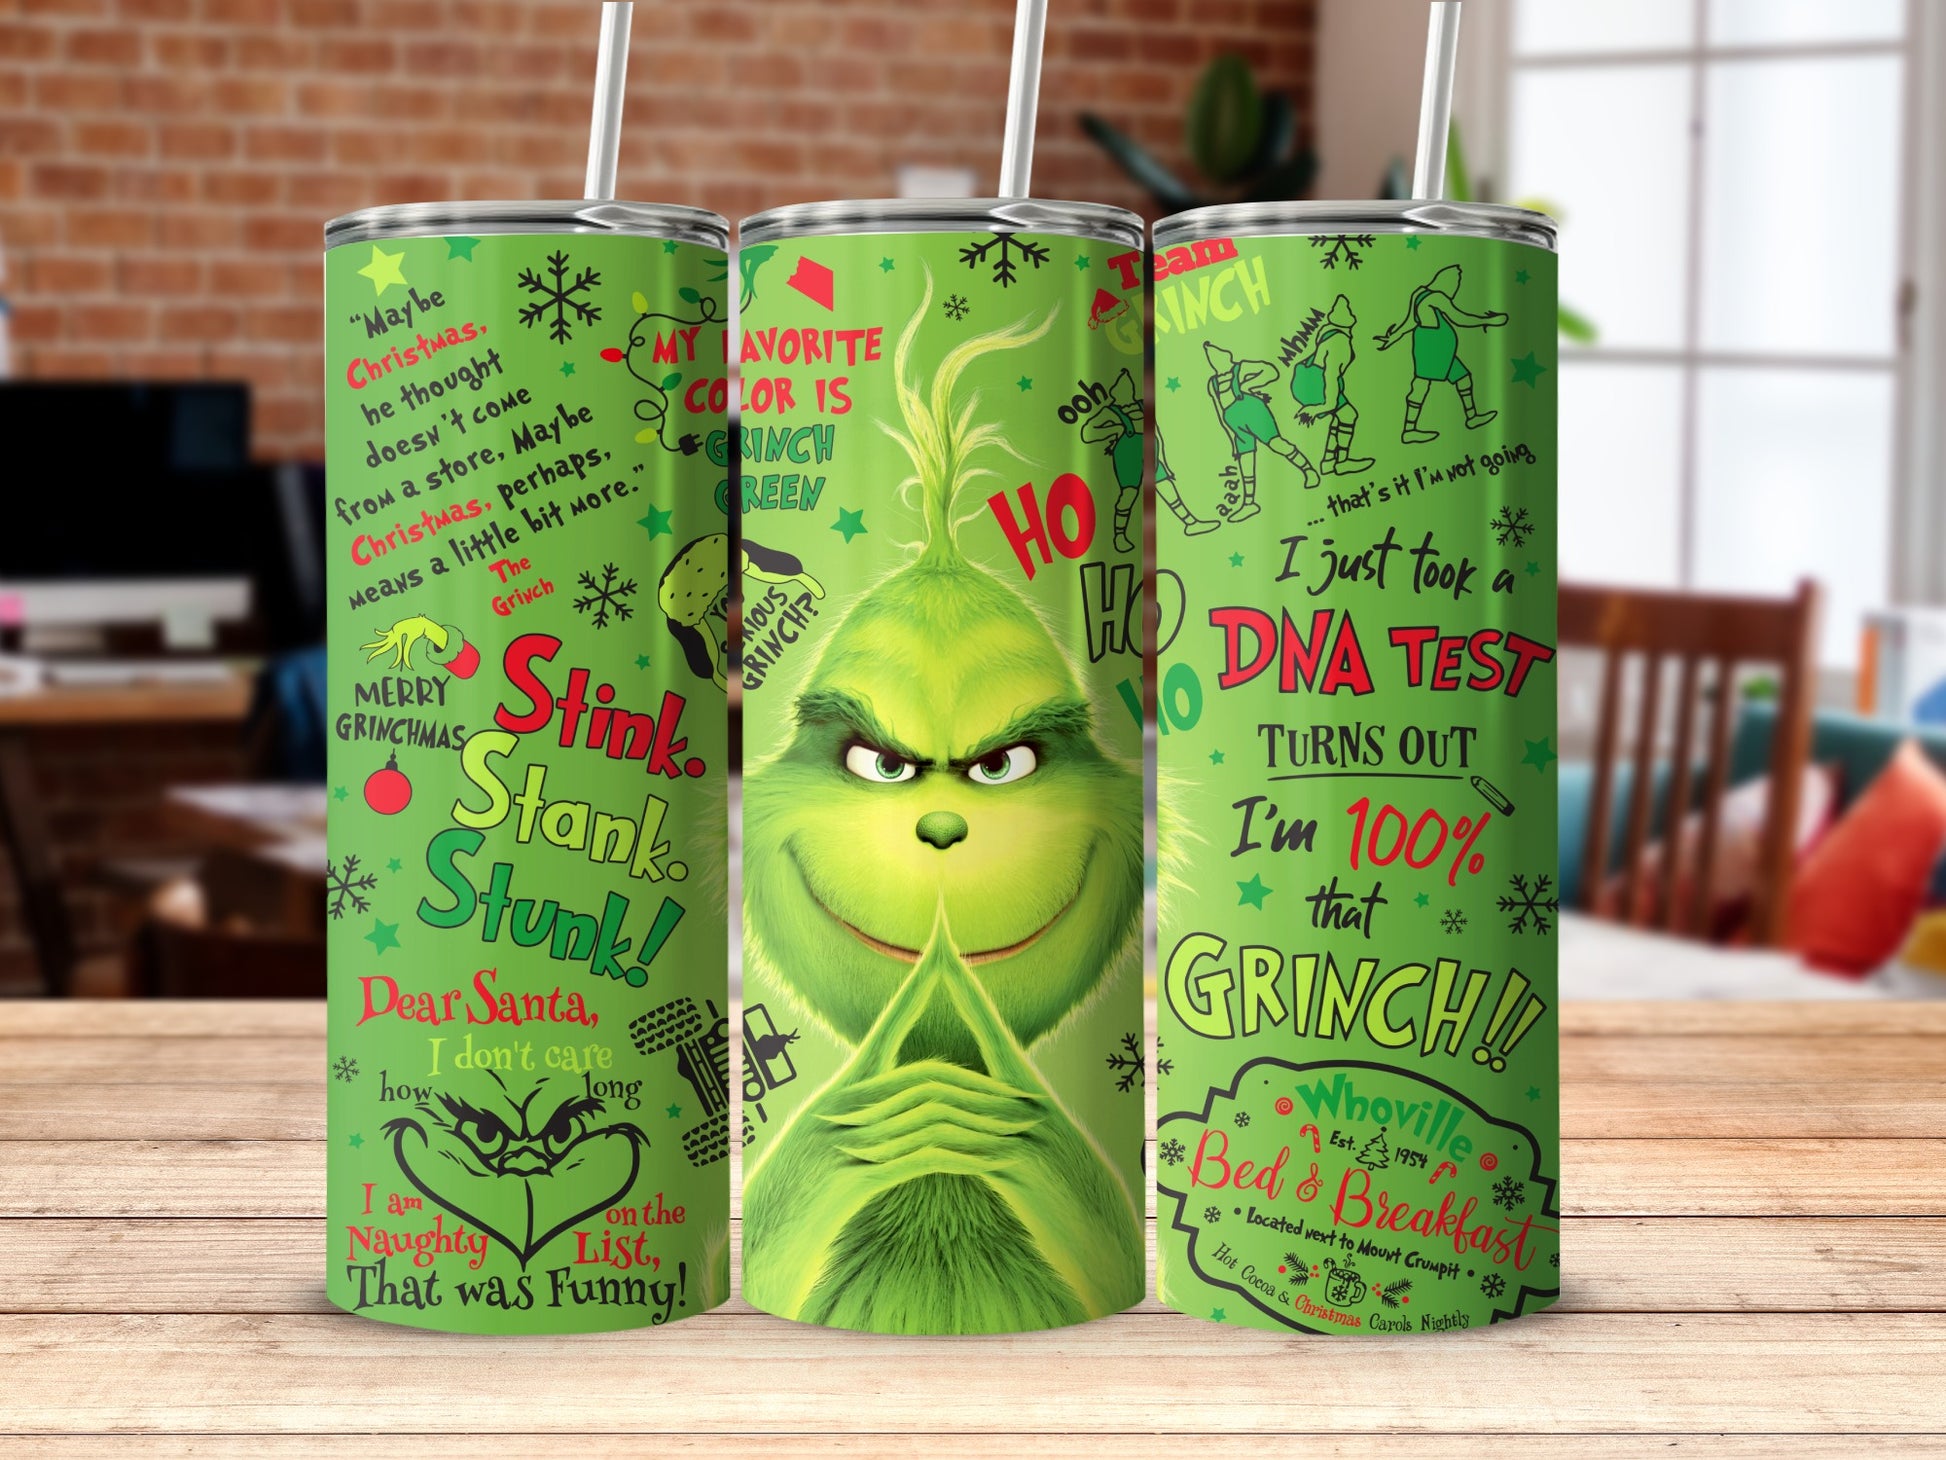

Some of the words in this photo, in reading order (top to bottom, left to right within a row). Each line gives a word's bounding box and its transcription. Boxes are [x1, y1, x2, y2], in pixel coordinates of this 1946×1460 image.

[1107, 238, 1239, 290] Team
[346, 322, 488, 389] Christmas,
[652, 327, 702, 365] MY
[360, 402, 395, 426] he
[400, 347, 505, 402] thought
[816, 377, 853, 415] IS
[1058, 380, 1109, 425] ooh
[366, 409, 468, 468] doesn't
[472, 388, 532, 424] come
[335, 488, 396, 526] from
[401, 479, 421, 498] a
[426, 448, 506, 492] store,
[511, 403, 594, 455] Maybe
[1216, 465, 1239, 517] aaah
[1393, 474, 1411, 496] it
[1414, 466, 1444, 490] I'm
[1446, 454, 1476, 483] not
[1480, 443, 1537, 476] going
[351, 498, 492, 567] Christmas,
[497, 446, 612, 510] perhaps,
[987, 472, 1096, 581] HO
[348, 567, 424, 610] means
[430, 557, 449, 576] a
[449, 521, 521, 567] little
[520, 500, 564, 534] bit
[488, 555, 532, 584] The
[1275, 535, 1308, 583] I
[1306, 526, 1403, 596] just
[1409, 531, 1478, 600] took
[1492, 568, 1515, 595] a
[491, 578, 555, 617] Grinch
[1080, 561, 1186, 663] HO
[742, 592, 819, 691] GRINCH?
[1208, 605, 1375, 697] DNA
[1387, 625, 1557, 698] TEST
[354, 675, 451, 707] MERRY
[494, 633, 706, 779] Stink.
[336, 713, 467, 751] GRINCHMAS
[1257, 721, 1386, 768] TURNS
[1399, 725, 1477, 768] OUT
[451, 729, 689, 883] Stank.
[1230, 795, 1318, 858] I'm
[1346, 796, 1492, 887] 100%
[416, 828, 686, 988] Stunk!
[1305, 876, 1388, 939] that
[356, 975, 461, 1027] Dear
[465, 967, 599, 1027] Santa,
[1164, 931, 1547, 1073] GRINCH!!
[378, 1070, 433, 1103] how
[584, 1072, 643, 1110] long
[427, 1038, 447, 1077] I
[454, 1034, 535, 1072] don't
[544, 1042, 613, 1074] care
[1295, 1073, 1473, 1163] Whoville
[1329, 1130, 1356, 1152] Est.
[1394, 1146, 1429, 1170] 1954
[361, 1182, 378, 1216] I
[387, 1193, 423, 1216] am
[605, 1206, 637, 1226] on
[642, 1193, 686, 1226] the
[1187, 1129, 1290, 1200] Bed
[1296, 1162, 1324, 1202] &
[1329, 1167, 1559, 1272] Breakfast
[345, 1214, 489, 1270] Naughty
[573, 1230, 661, 1272] List,
[1246, 1206, 1304, 1236] Located
[1304, 1228, 1337, 1247] next
[1339, 1233, 1354, 1250] to
[1356, 1238, 1402, 1264] Mount
[1404, 1251, 1460, 1280] Crumpit
[346, 1257, 442, 1312] That
[455, 1273, 534, 1310] was
[545, 1261, 687, 1326] Funny!
[1211, 1241, 1239, 1270] Hot
[1241, 1264, 1276, 1297] Cocoa
[1278, 1291, 1290, 1306] &
[1295, 1293, 1361, 1328] Christmas
[1369, 1313, 1413, 1333] Carols
[1421, 1309, 1470, 1332] Nightly
